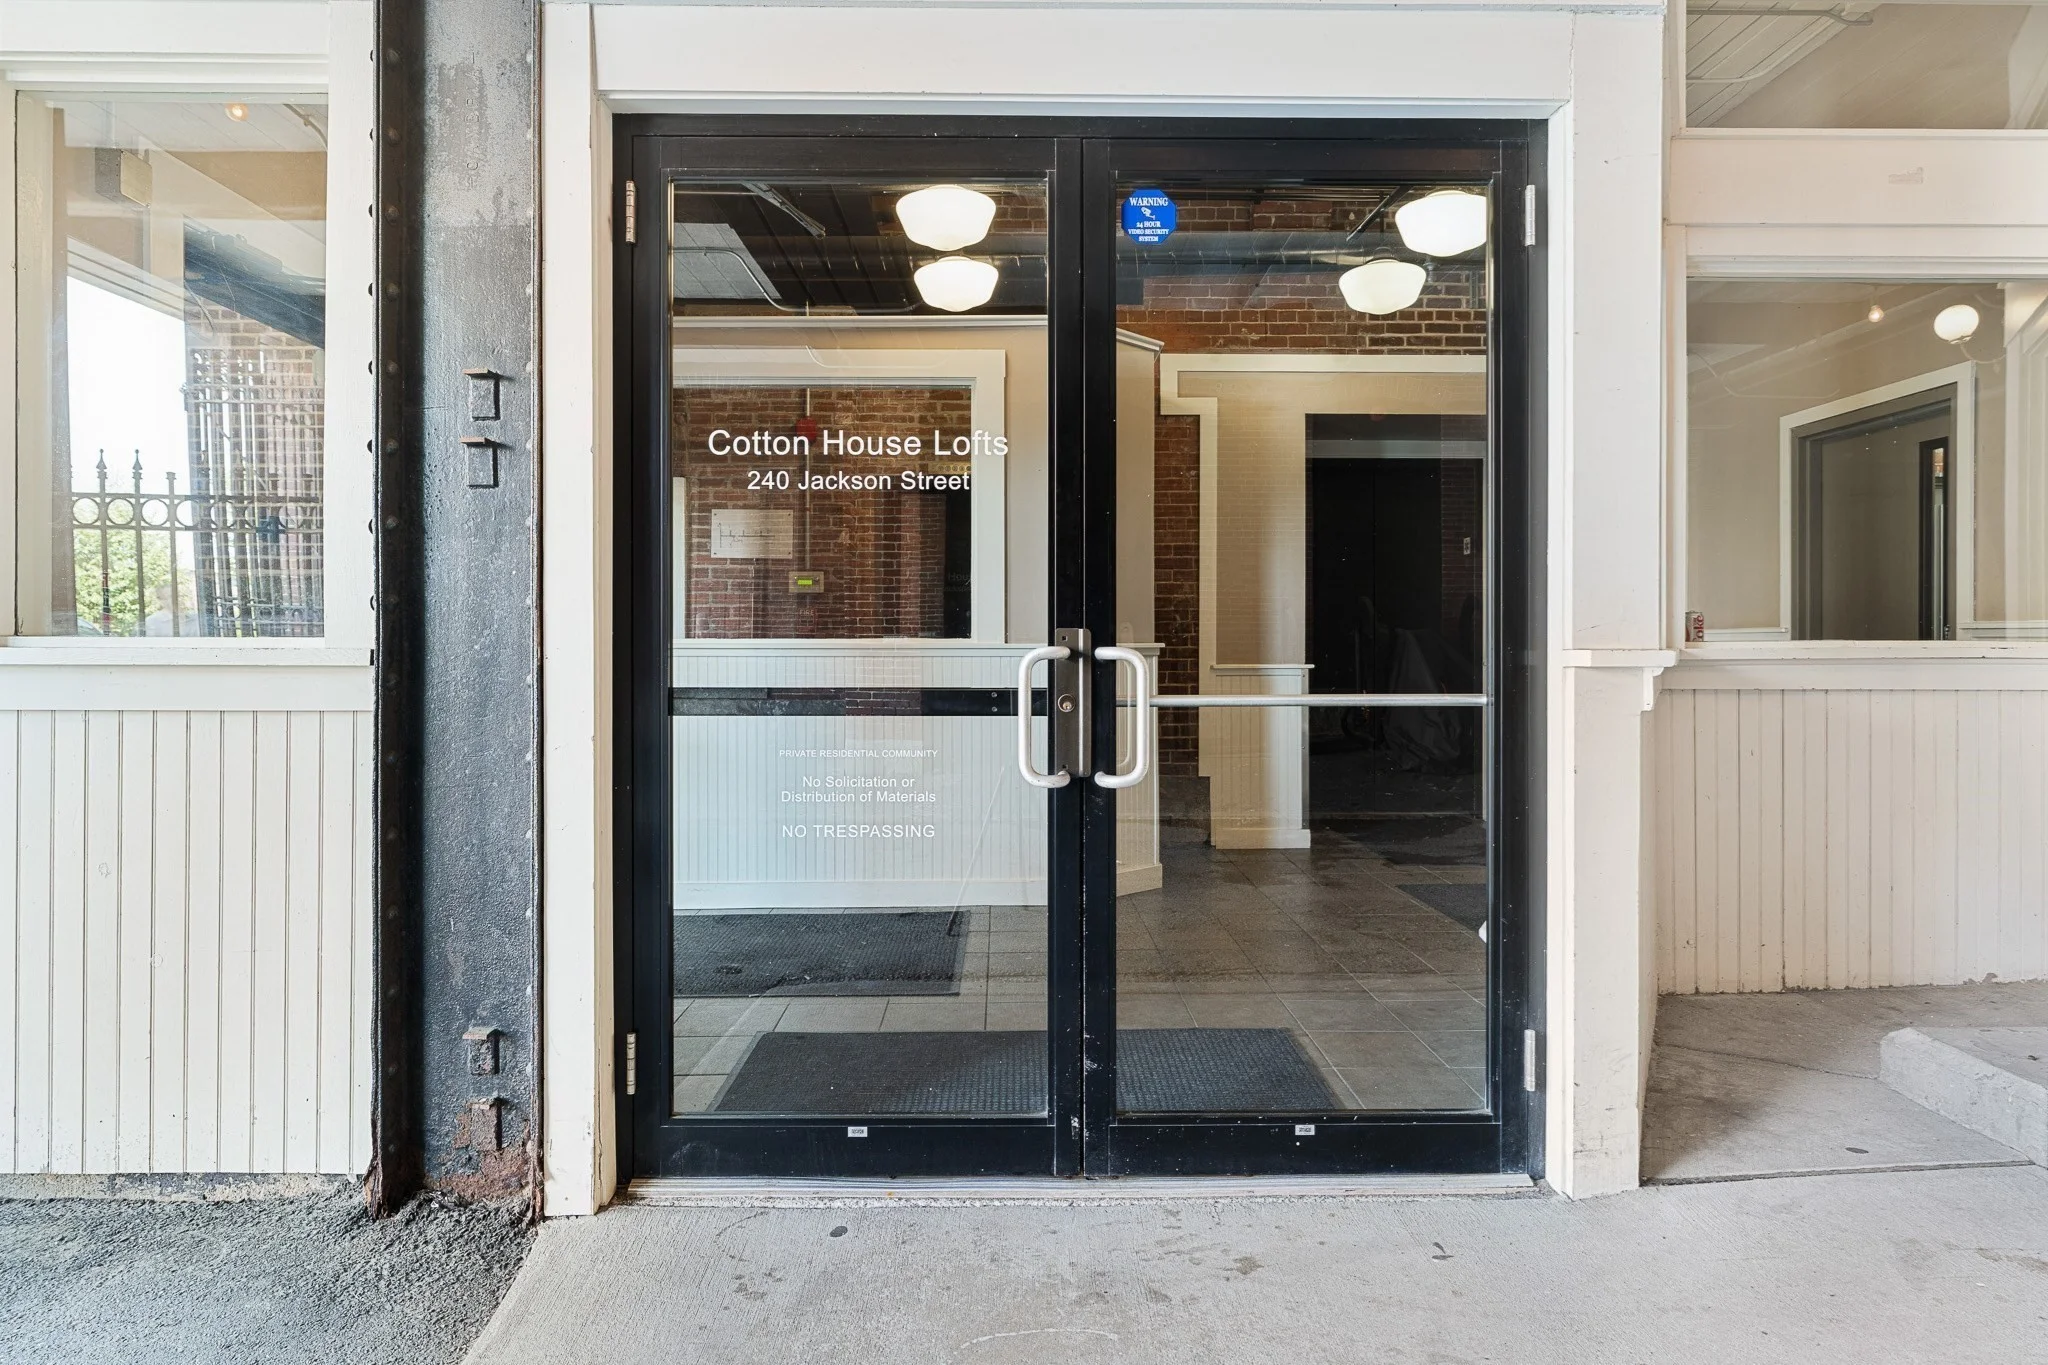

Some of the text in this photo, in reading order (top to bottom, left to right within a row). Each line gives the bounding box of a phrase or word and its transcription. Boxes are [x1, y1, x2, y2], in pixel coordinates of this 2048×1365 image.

[1129, 197, 1168, 206] WARNING
[708, 429, 1009, 456] Cotton House Lofts
[747, 470, 970, 490] 240 Jackson Street
[779, 750, 938, 758] PRIVATE RESIDENTIAL COMMUNITY
[802, 776, 915, 788] No Solicitation or
[781, 791, 936, 802] Distribution of Materials
[782, 825, 935, 838] NO TRESPASSING
